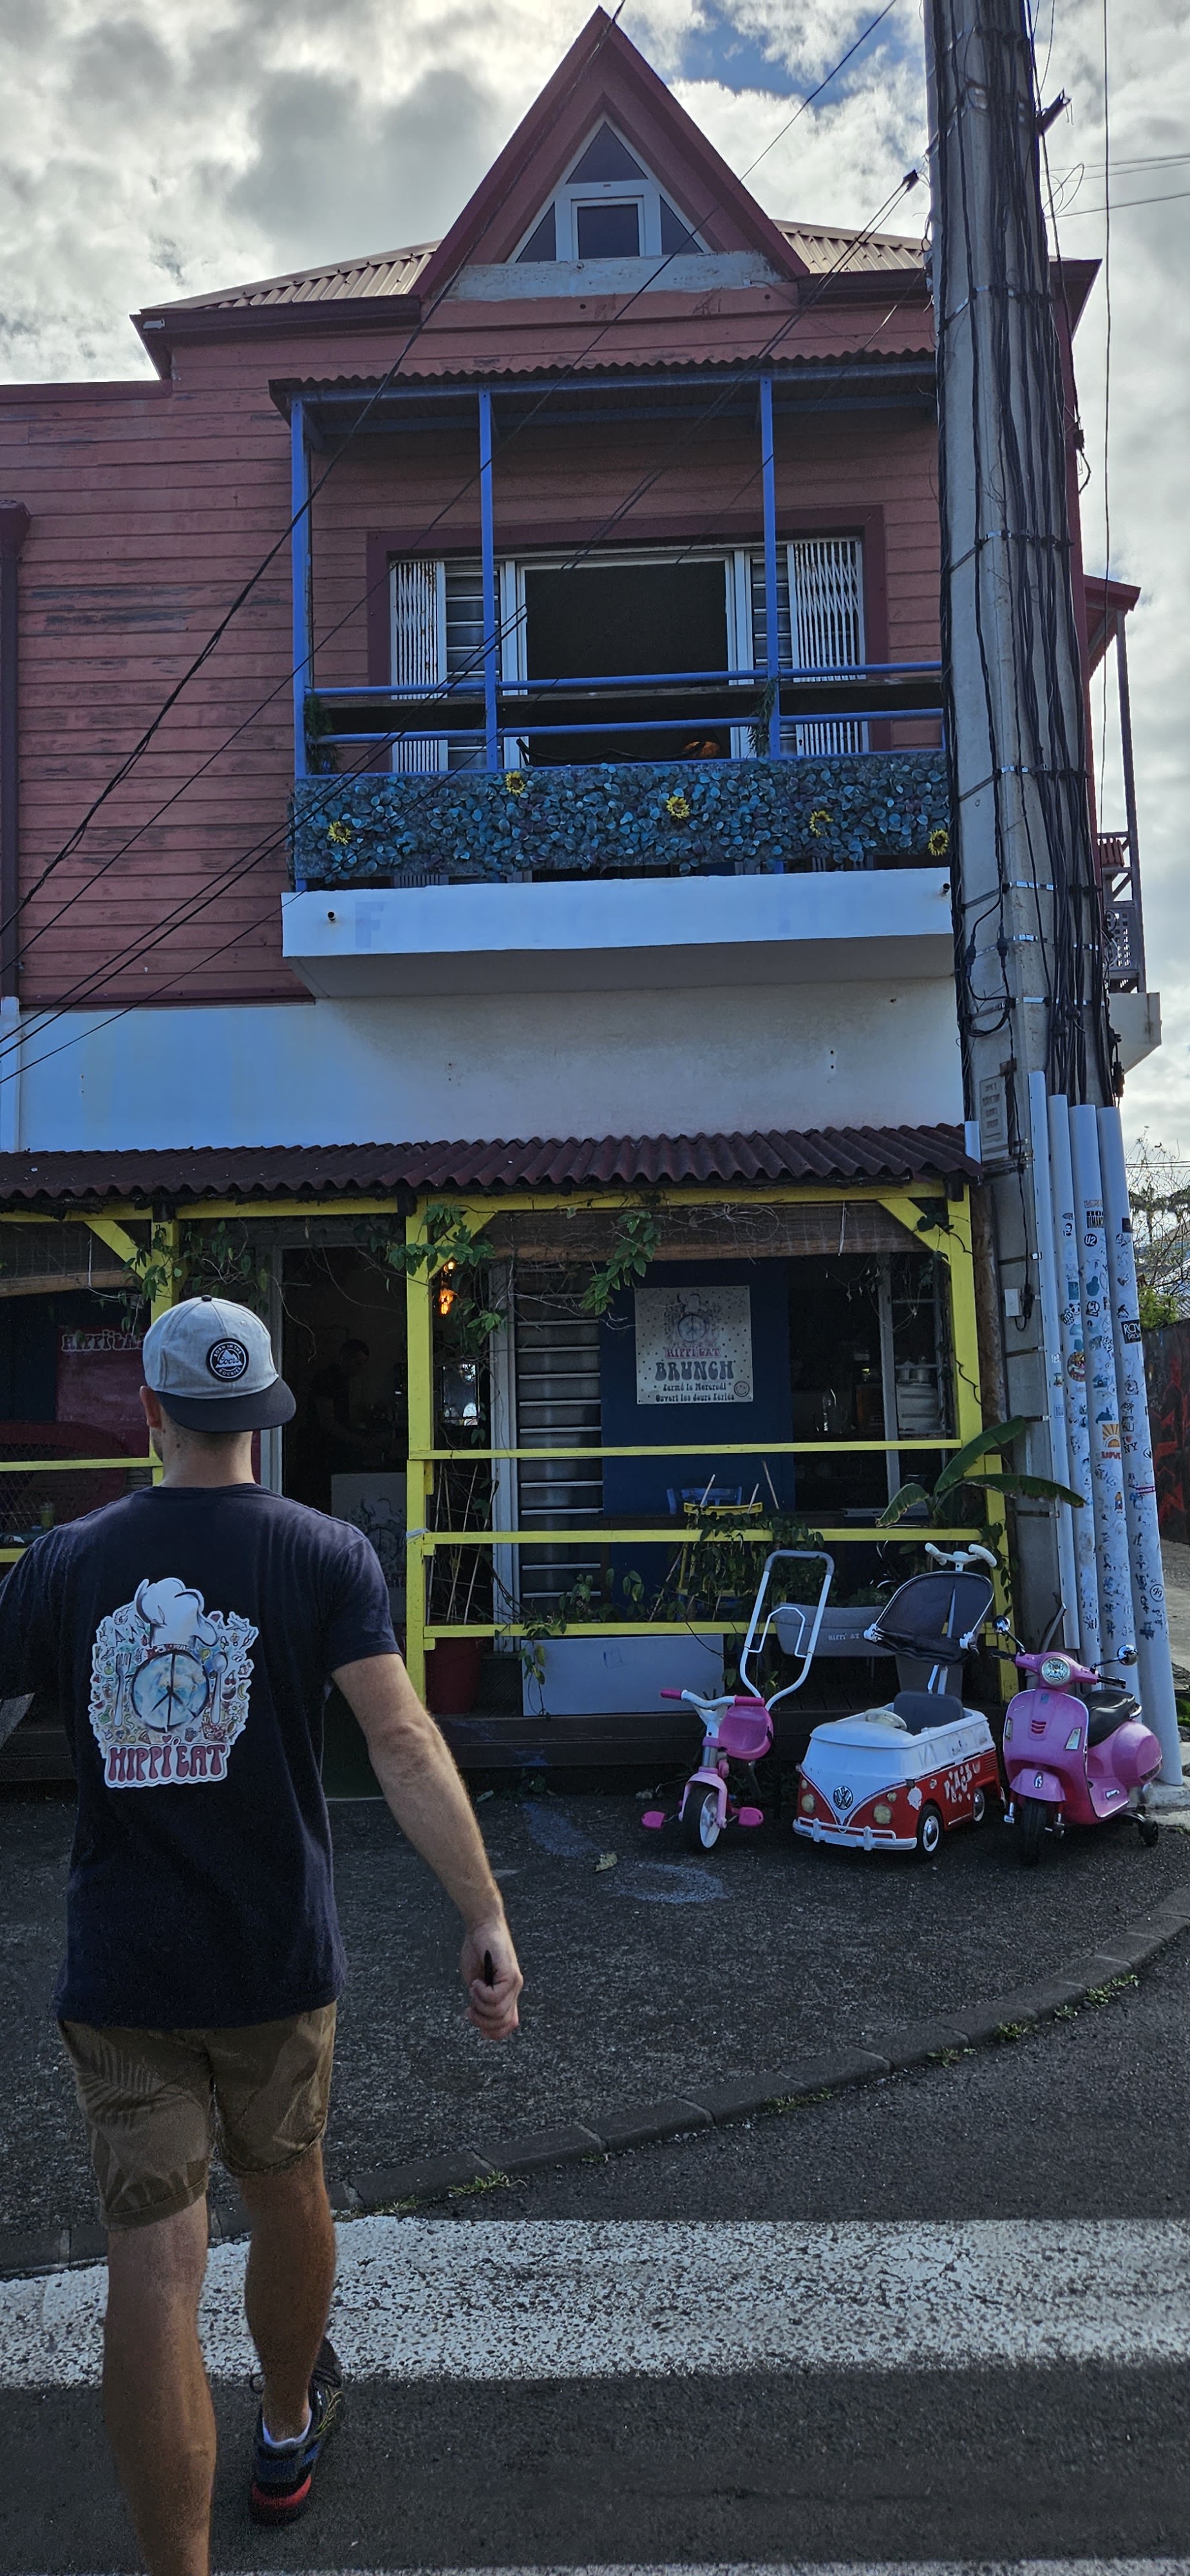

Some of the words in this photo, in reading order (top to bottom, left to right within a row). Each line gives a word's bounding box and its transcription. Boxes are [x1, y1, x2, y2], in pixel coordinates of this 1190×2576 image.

[1085, 1235, 1096, 1245] U2
[213, 1345, 226, 1358] BORN
[219, 1356, 240, 1365] Coors
[654, 1360, 734, 1381] BRUNCH
[1122, 1437, 1127, 1446] I
[1123, 1441, 1138, 1454] NY
